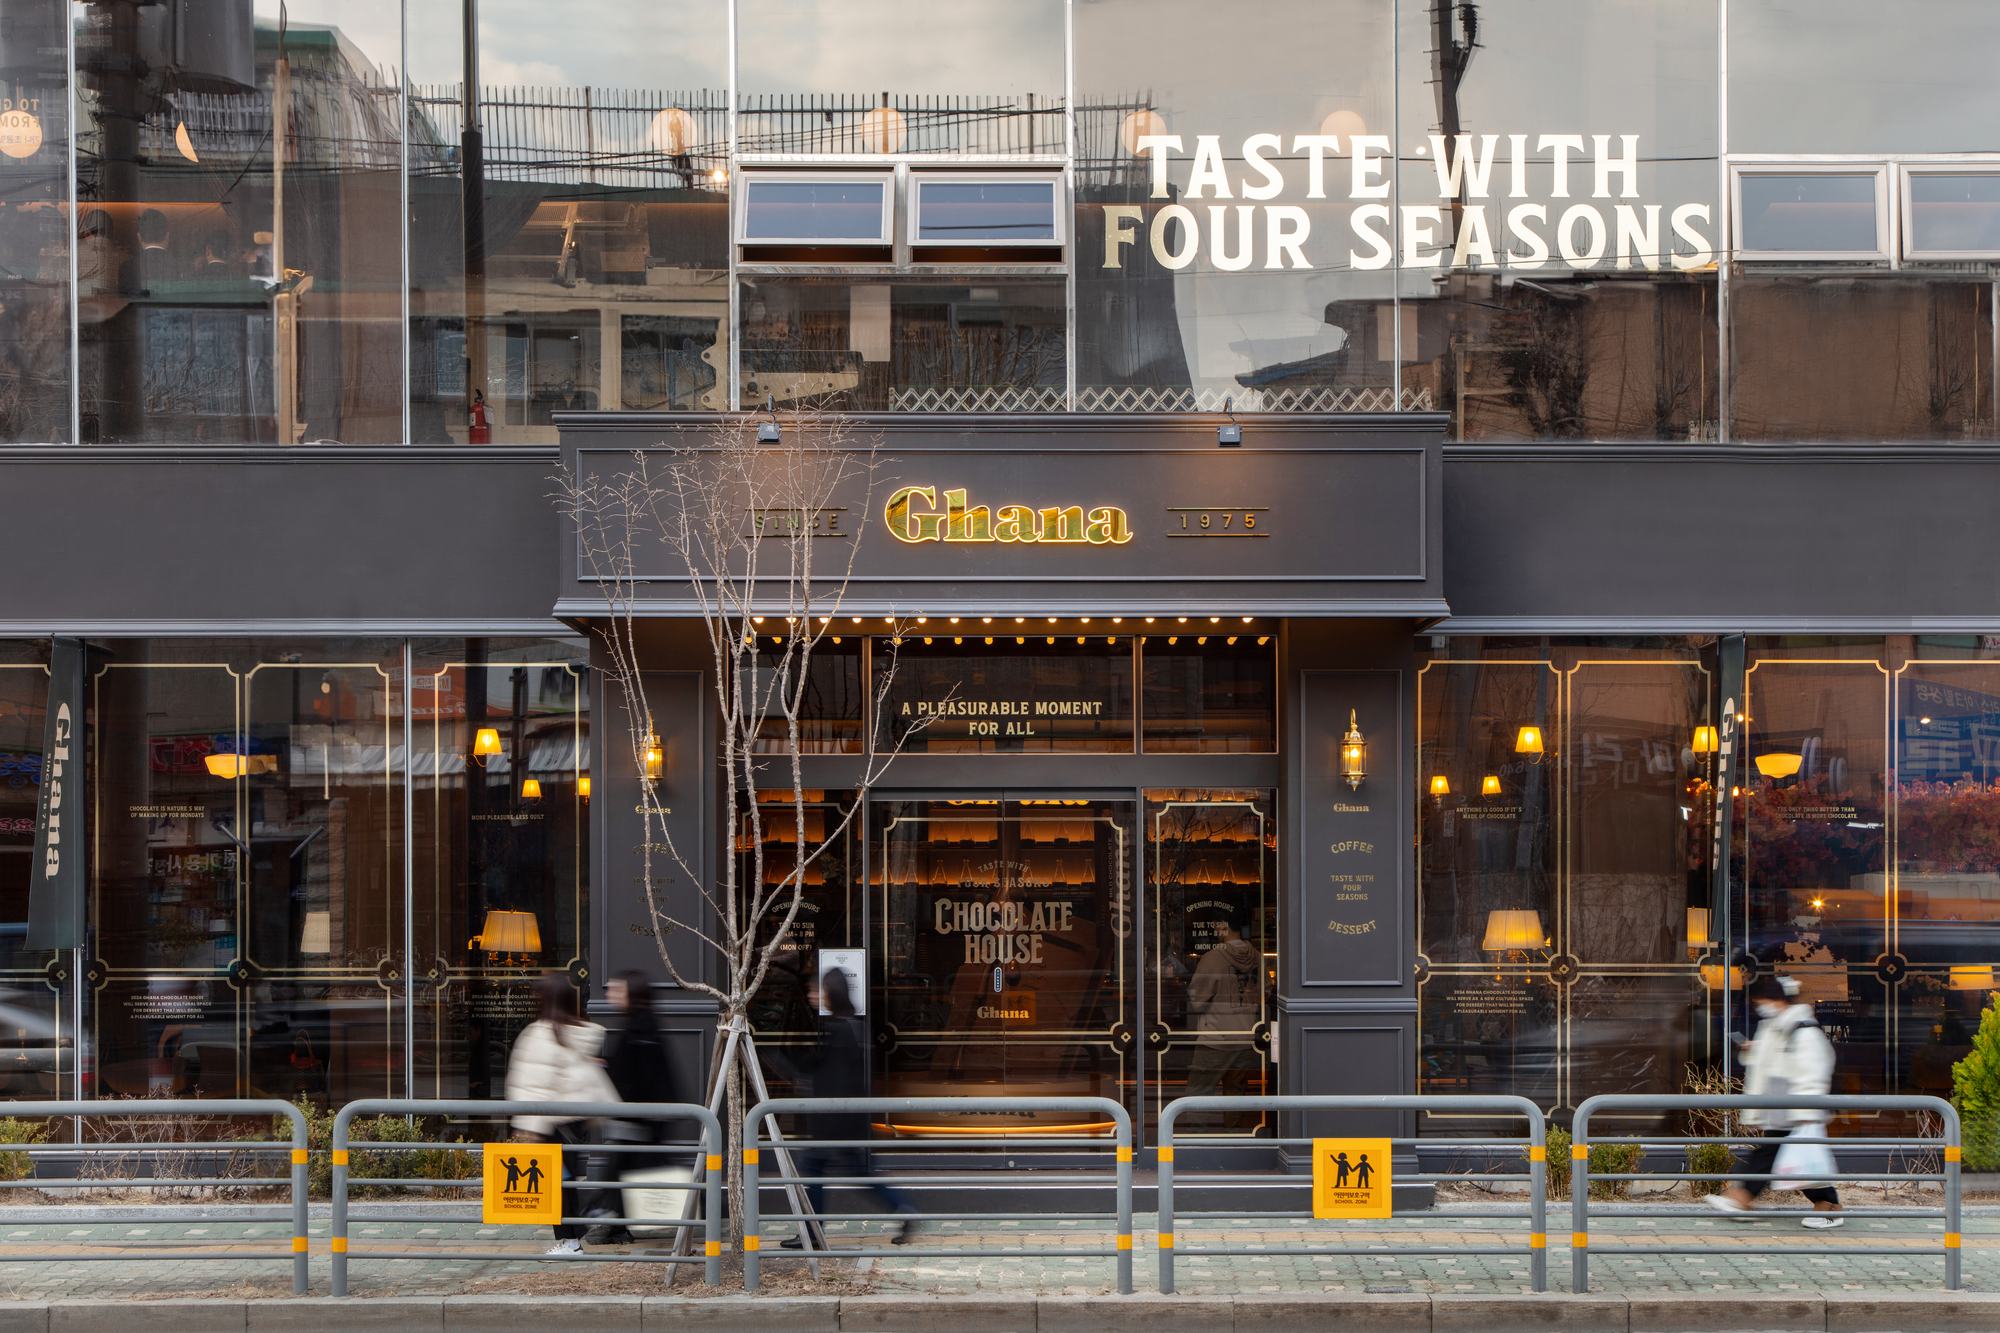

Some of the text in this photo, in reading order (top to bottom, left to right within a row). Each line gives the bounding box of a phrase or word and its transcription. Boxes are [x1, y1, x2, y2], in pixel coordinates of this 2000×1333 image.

[1136, 133, 1640, 200] TASTE WITH
[1102, 203, 1713, 271] FOUR SEASONS
[885, 486, 1134, 545] Ghana
[1179, 513, 1256, 529] 1975
[902, 702, 1103, 715] A PLEASURABLE MOMENT
[969, 722, 1035, 735] FOR ALL
[45, 702, 71, 881] Ghana
[634, 804, 671, 814] Gana
[1333, 803, 1370, 813] Ghana
[1331, 841, 1374, 854] COFFEE
[772, 902, 821, 913] OPENIN HOURS
[1186, 900, 1235, 913] OPENING HOURS
[934, 898, 1073, 935] CHOCOLATE
[1328, 920, 1377, 935] DESSERT
[964, 934, 1043, 964] HOUSE
[977, 1006, 1030, 1019] Ghana
